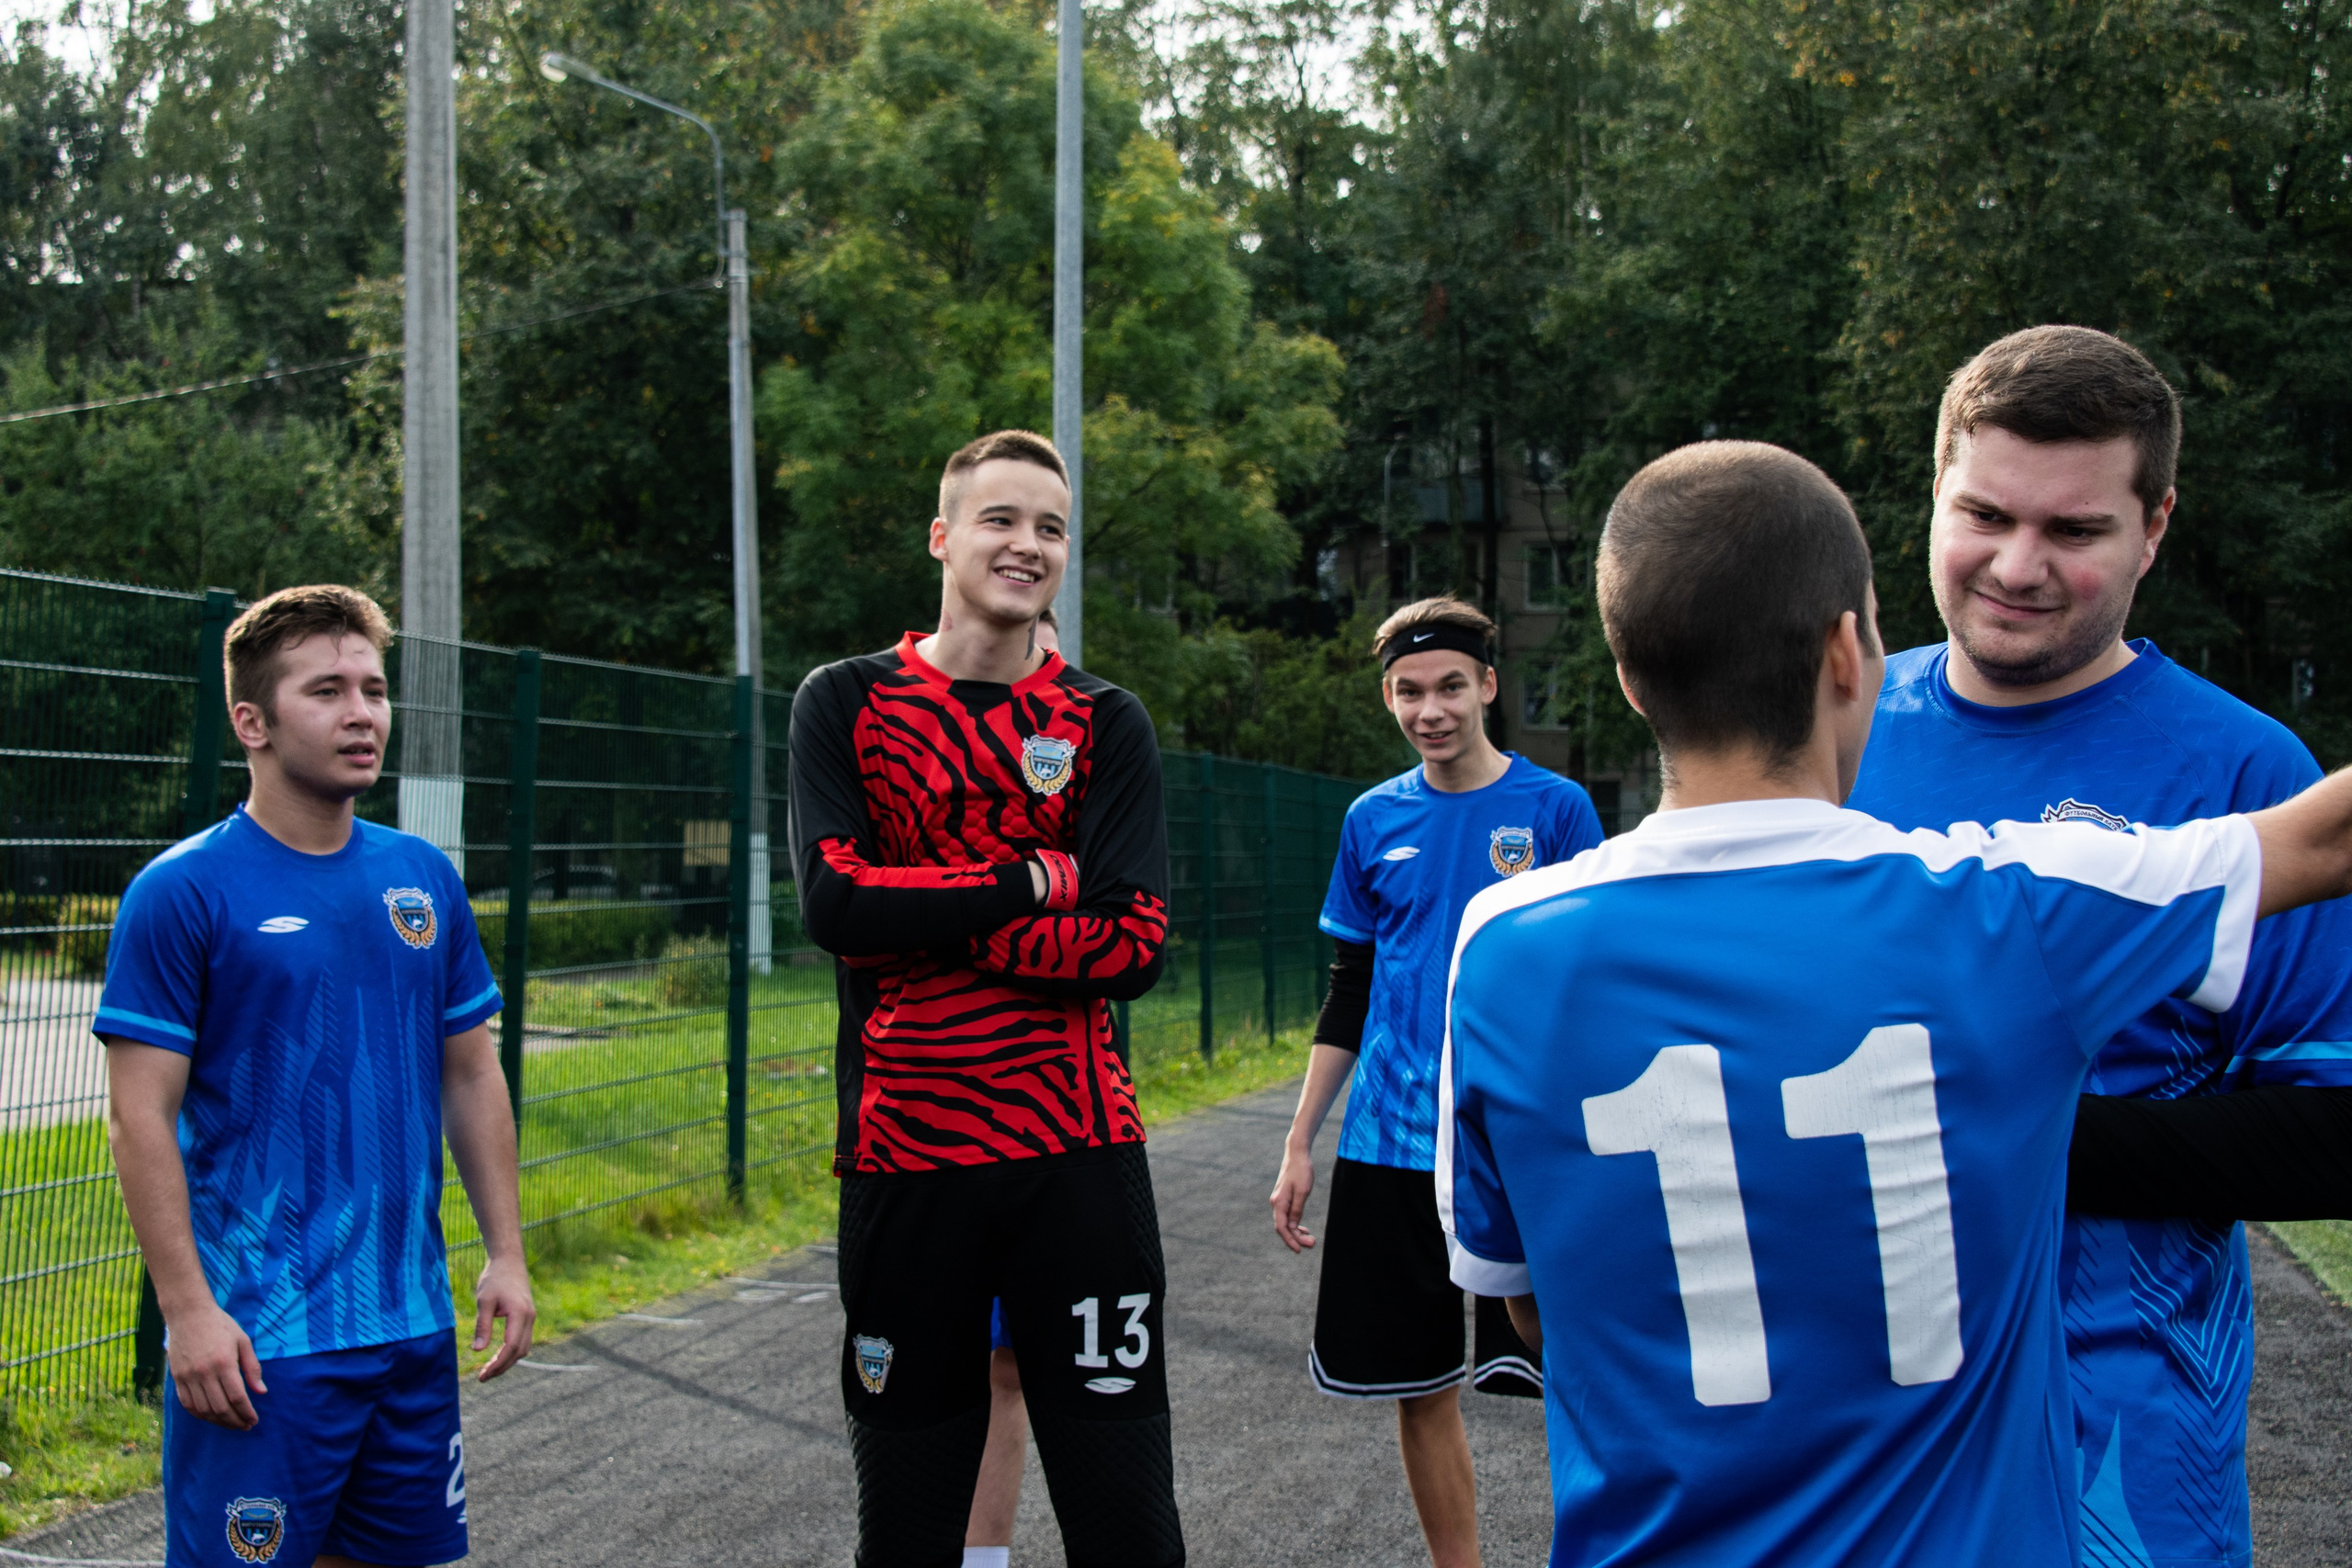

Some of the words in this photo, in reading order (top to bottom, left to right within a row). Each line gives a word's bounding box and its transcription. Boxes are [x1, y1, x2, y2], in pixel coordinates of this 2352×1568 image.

[1048, 853, 1068, 903] DEMIX
[1581, 1022, 1965, 1407] 11
[1071, 1292, 1151, 1369] 13
